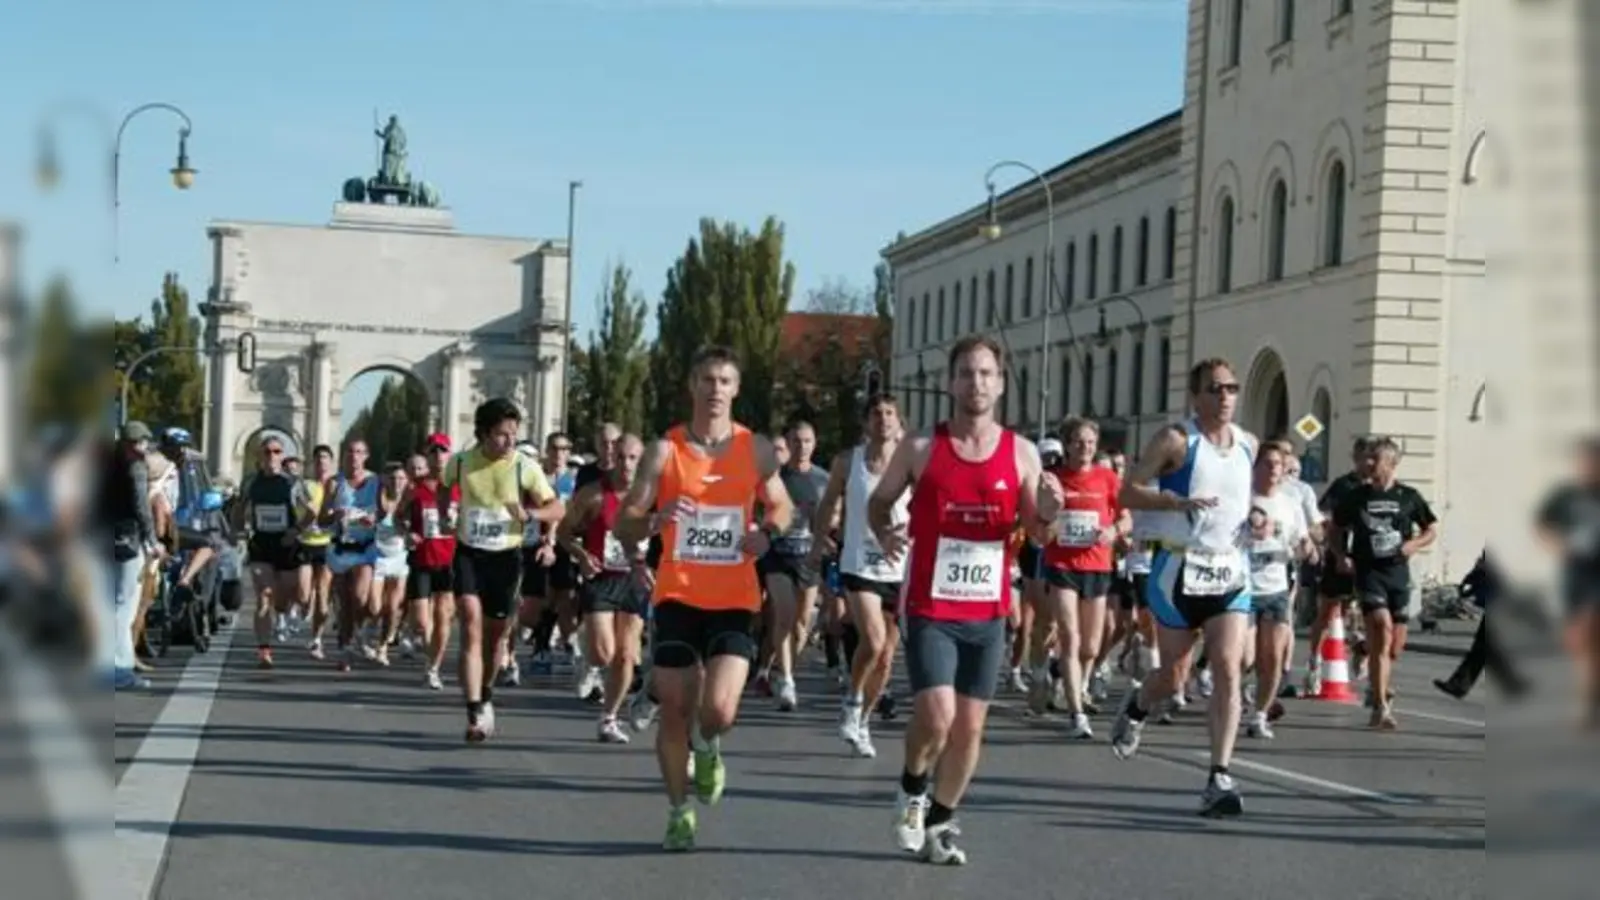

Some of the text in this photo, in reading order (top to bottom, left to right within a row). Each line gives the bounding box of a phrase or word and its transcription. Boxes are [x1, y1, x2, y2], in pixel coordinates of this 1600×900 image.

[686, 527, 733, 549] 2829
[946, 562, 992, 585] 3102
[1195, 563, 1232, 583] 7540
